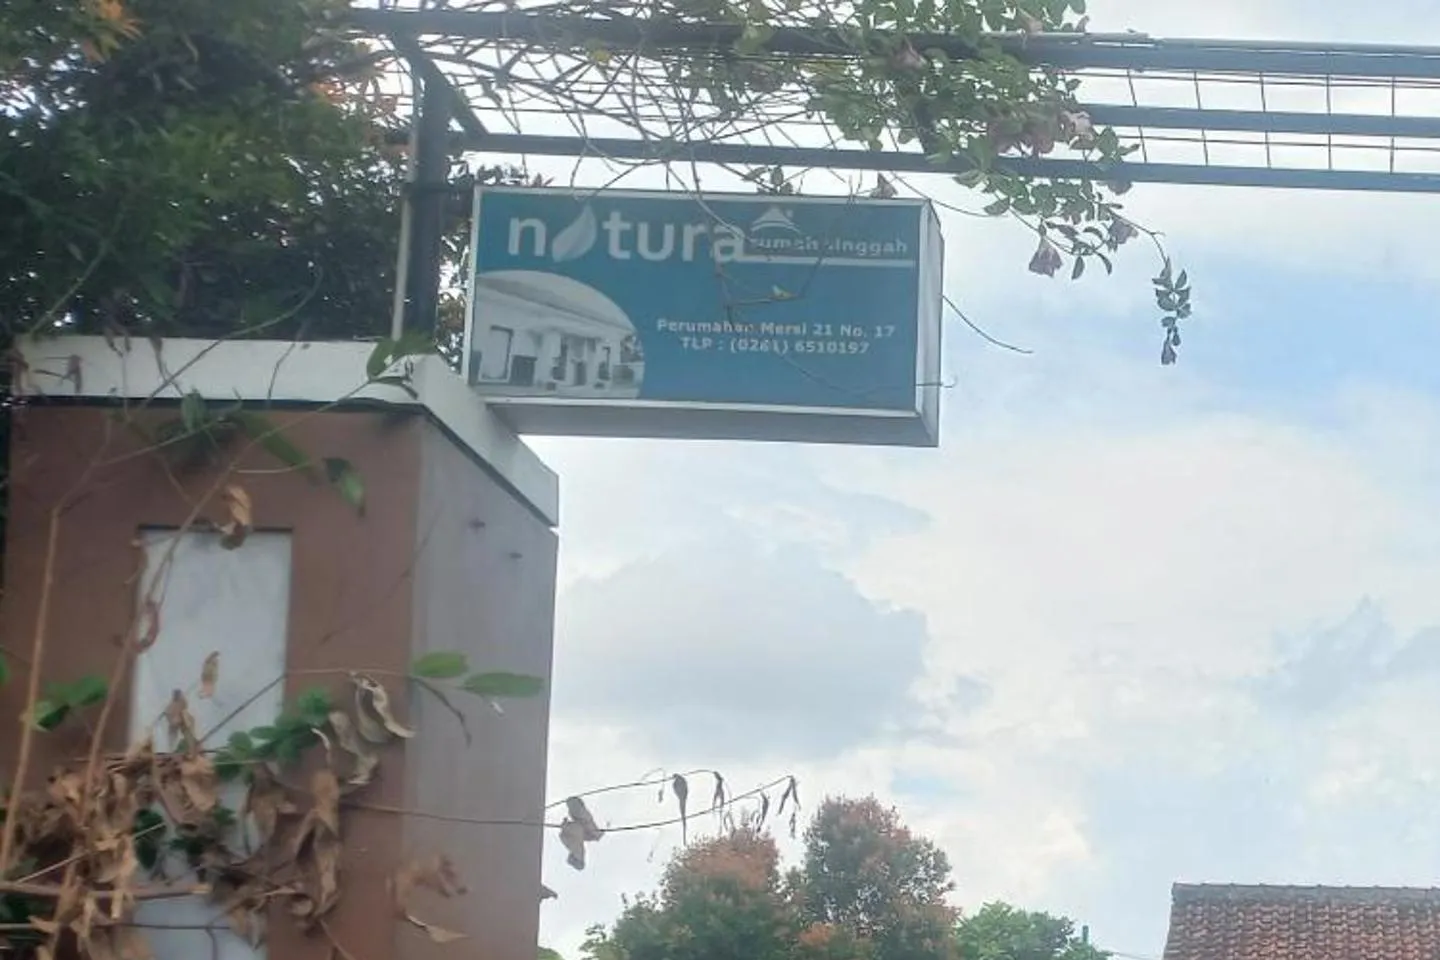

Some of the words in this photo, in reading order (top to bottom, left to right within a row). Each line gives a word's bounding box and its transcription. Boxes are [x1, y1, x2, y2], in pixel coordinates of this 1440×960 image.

[813, 323, 832, 335] 21
[840, 324, 867, 338] No.
[875, 324, 895, 338] 17
[681, 337, 712, 350] TLP
[795, 340, 870, 354] 6510197
